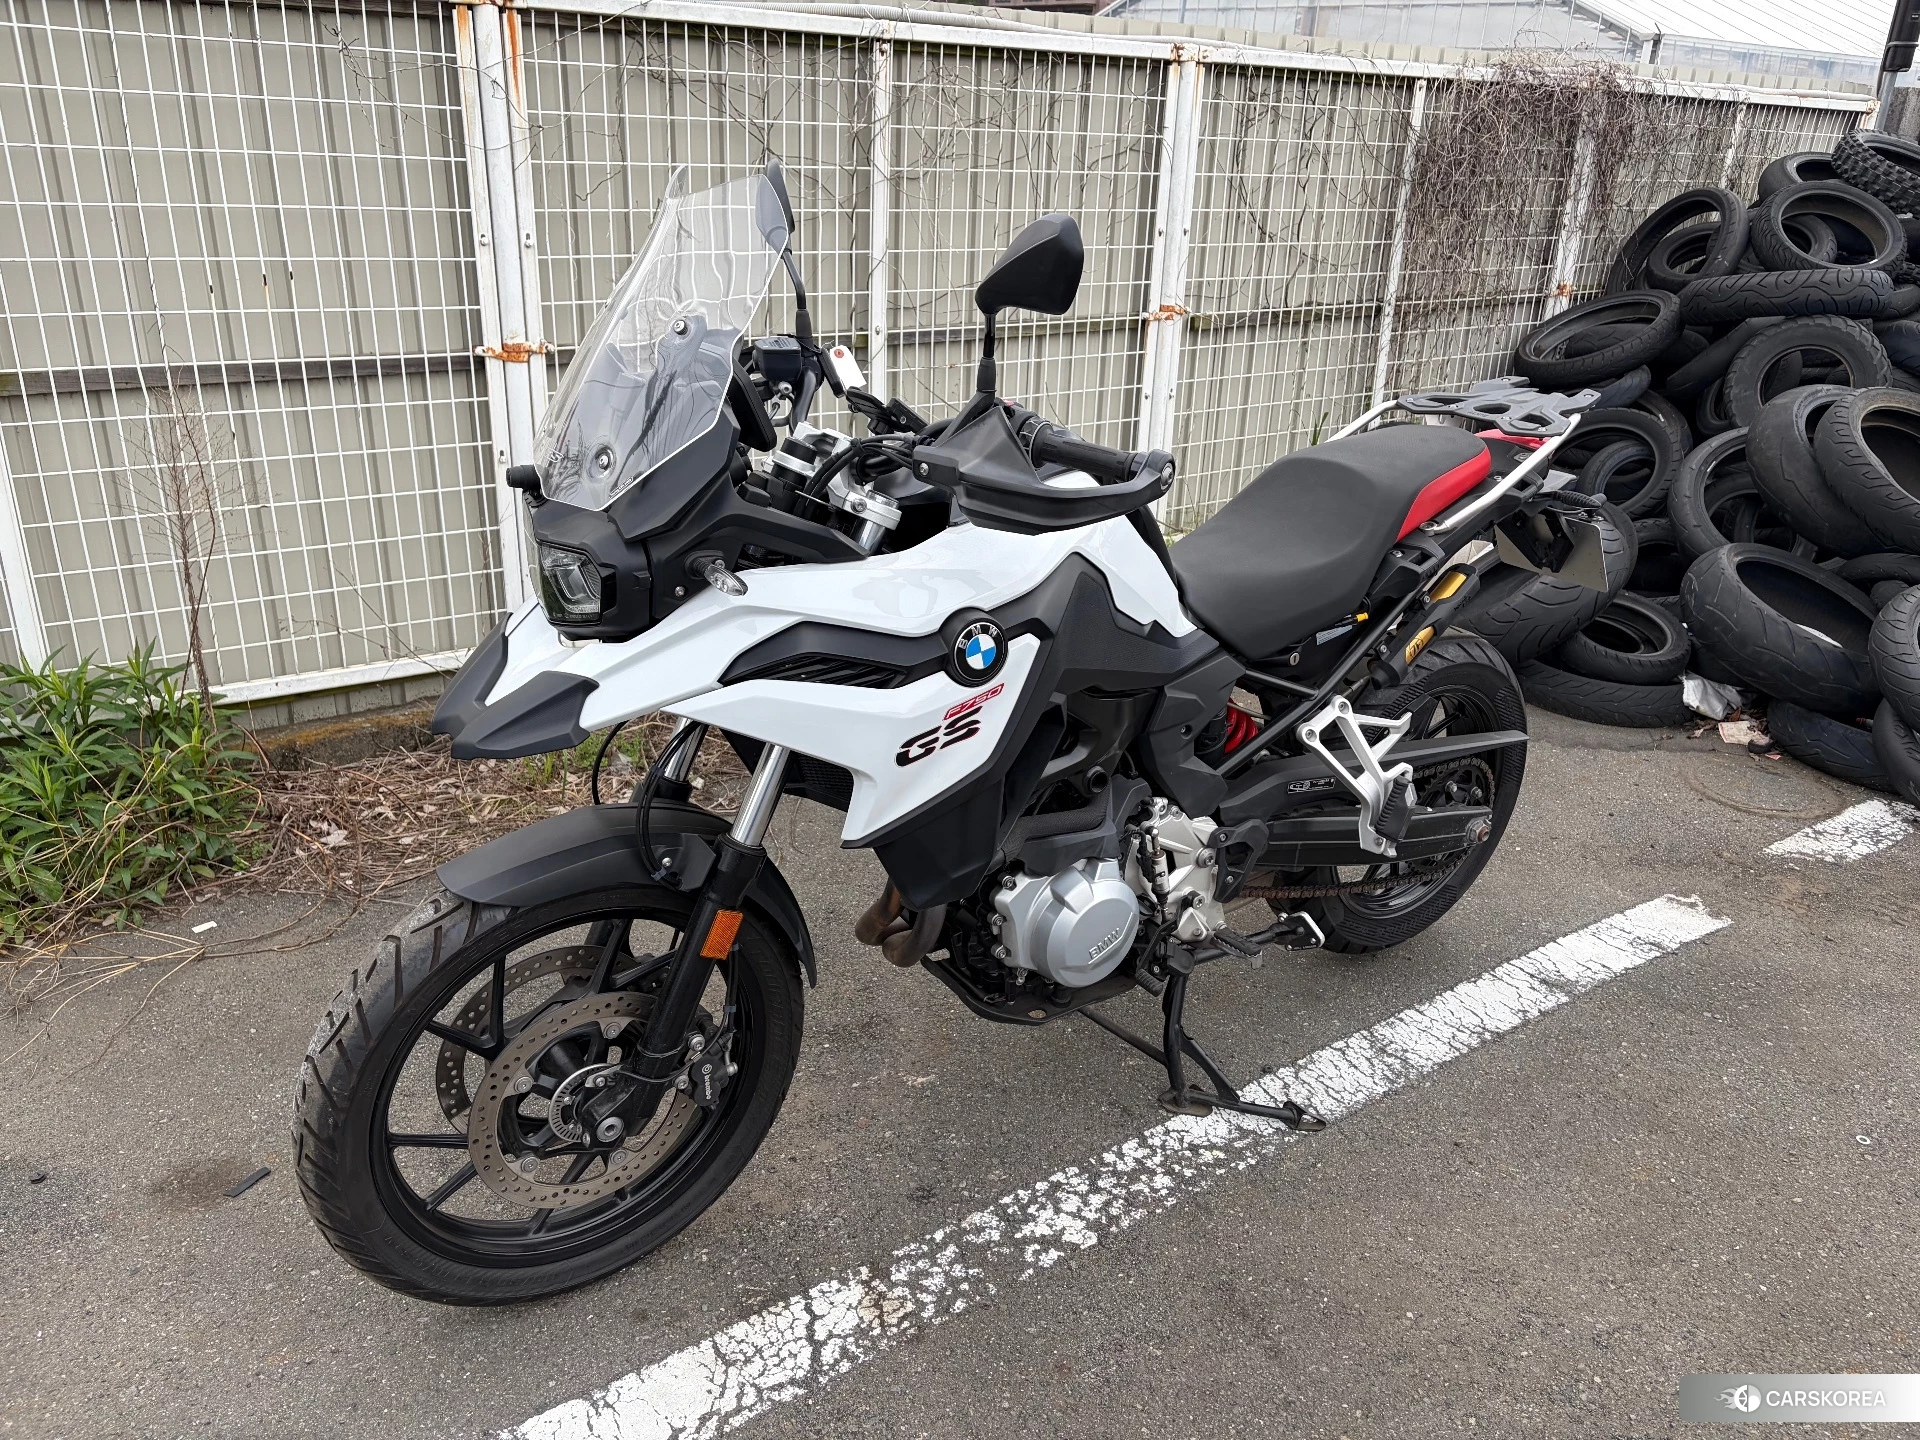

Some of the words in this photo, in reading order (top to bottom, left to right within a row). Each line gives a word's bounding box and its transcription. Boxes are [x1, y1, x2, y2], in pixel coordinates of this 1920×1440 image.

[959, 625, 999, 649] BMW
[946, 685, 1003, 719] F750
[895, 706, 983, 767] GS
[1088, 928, 1120, 959] BMW
